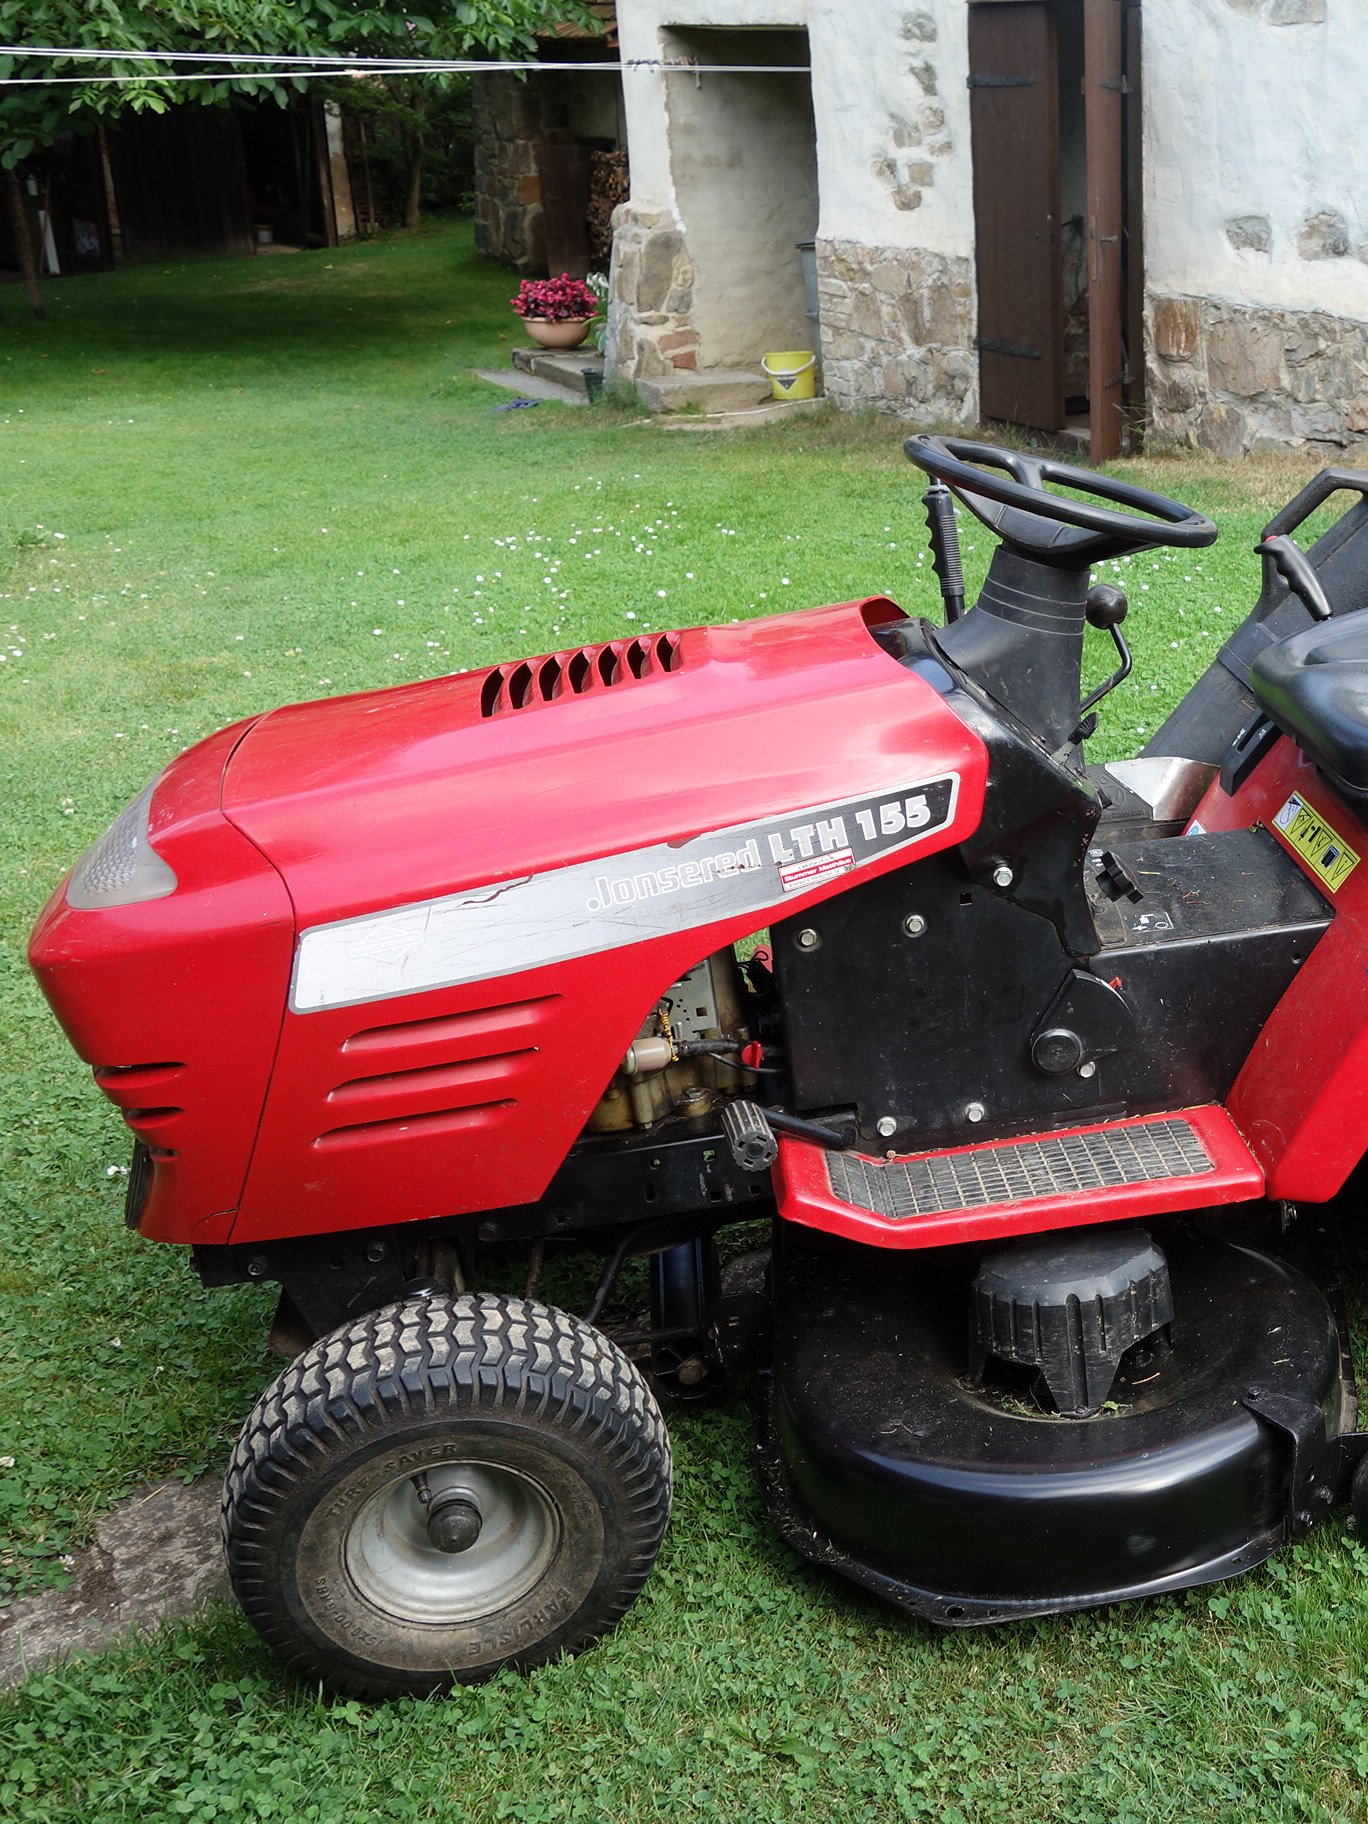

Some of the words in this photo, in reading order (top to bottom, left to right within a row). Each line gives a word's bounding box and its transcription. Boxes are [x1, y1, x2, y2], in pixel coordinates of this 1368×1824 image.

[586, 838, 763, 912] Jonsered
[767, 816, 850, 864] LTH
[854, 794, 931, 841] 155
[467, 1586, 573, 1656] CARLISLE
